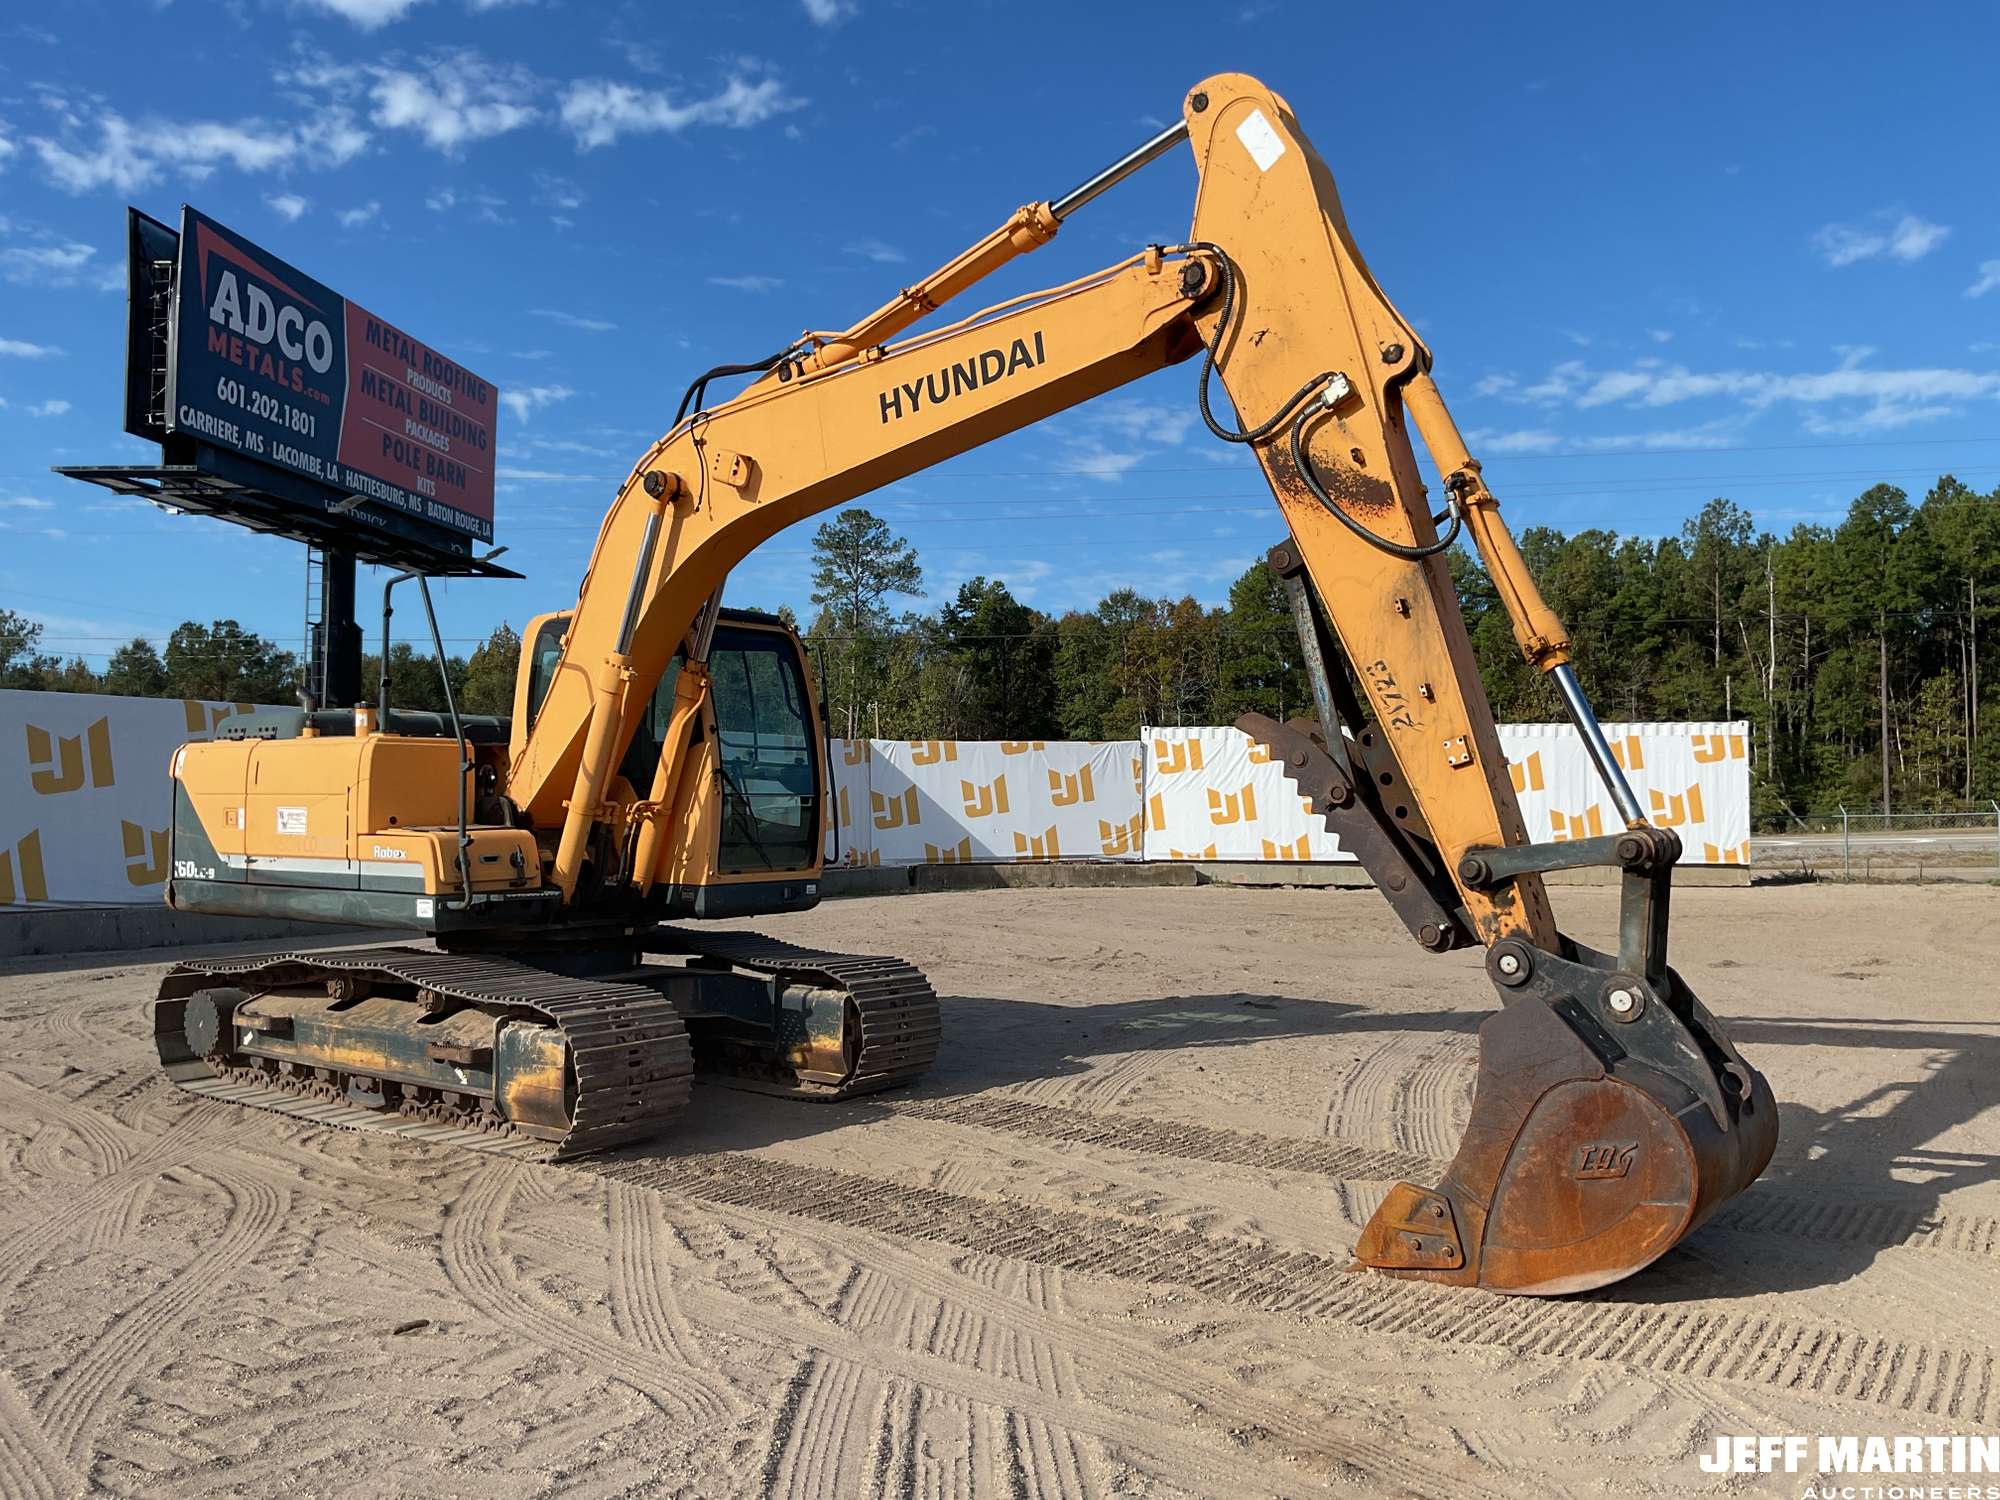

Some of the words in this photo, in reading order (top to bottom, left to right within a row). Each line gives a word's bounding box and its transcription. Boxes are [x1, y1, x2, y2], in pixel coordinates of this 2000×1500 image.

[210, 270, 333, 374] ADCO
[366, 319, 417, 368] METAL
[423, 351, 487, 405] ROOFING
[406, 368, 453, 404] PRODUCTS
[879, 331, 1046, 424] HYUNDAI
[217, 376, 316, 438] 601.202.1801
[361, 369, 413, 416] METAL
[418, 399, 487, 450] BUILDING
[405, 419, 450, 451] PACKAGES
[179, 404, 242, 449] CARRIERE,
[245, 430, 265, 453] MS
[272, 441, 325, 480] LACOMBE,
[326, 462, 339, 482] LA
[345, 470, 407, 511] HATTIESBURG,
[408, 494, 422, 513] MS
[427, 501, 454, 525] BATON
[454, 511, 482, 536] ROUGE,
[482, 521, 491, 537] LA
[383, 433, 420, 470] POLE
[426, 453, 466, 489] BARN
[416, 476, 436, 497] KITS
[374, 845, 407, 860] Robex
